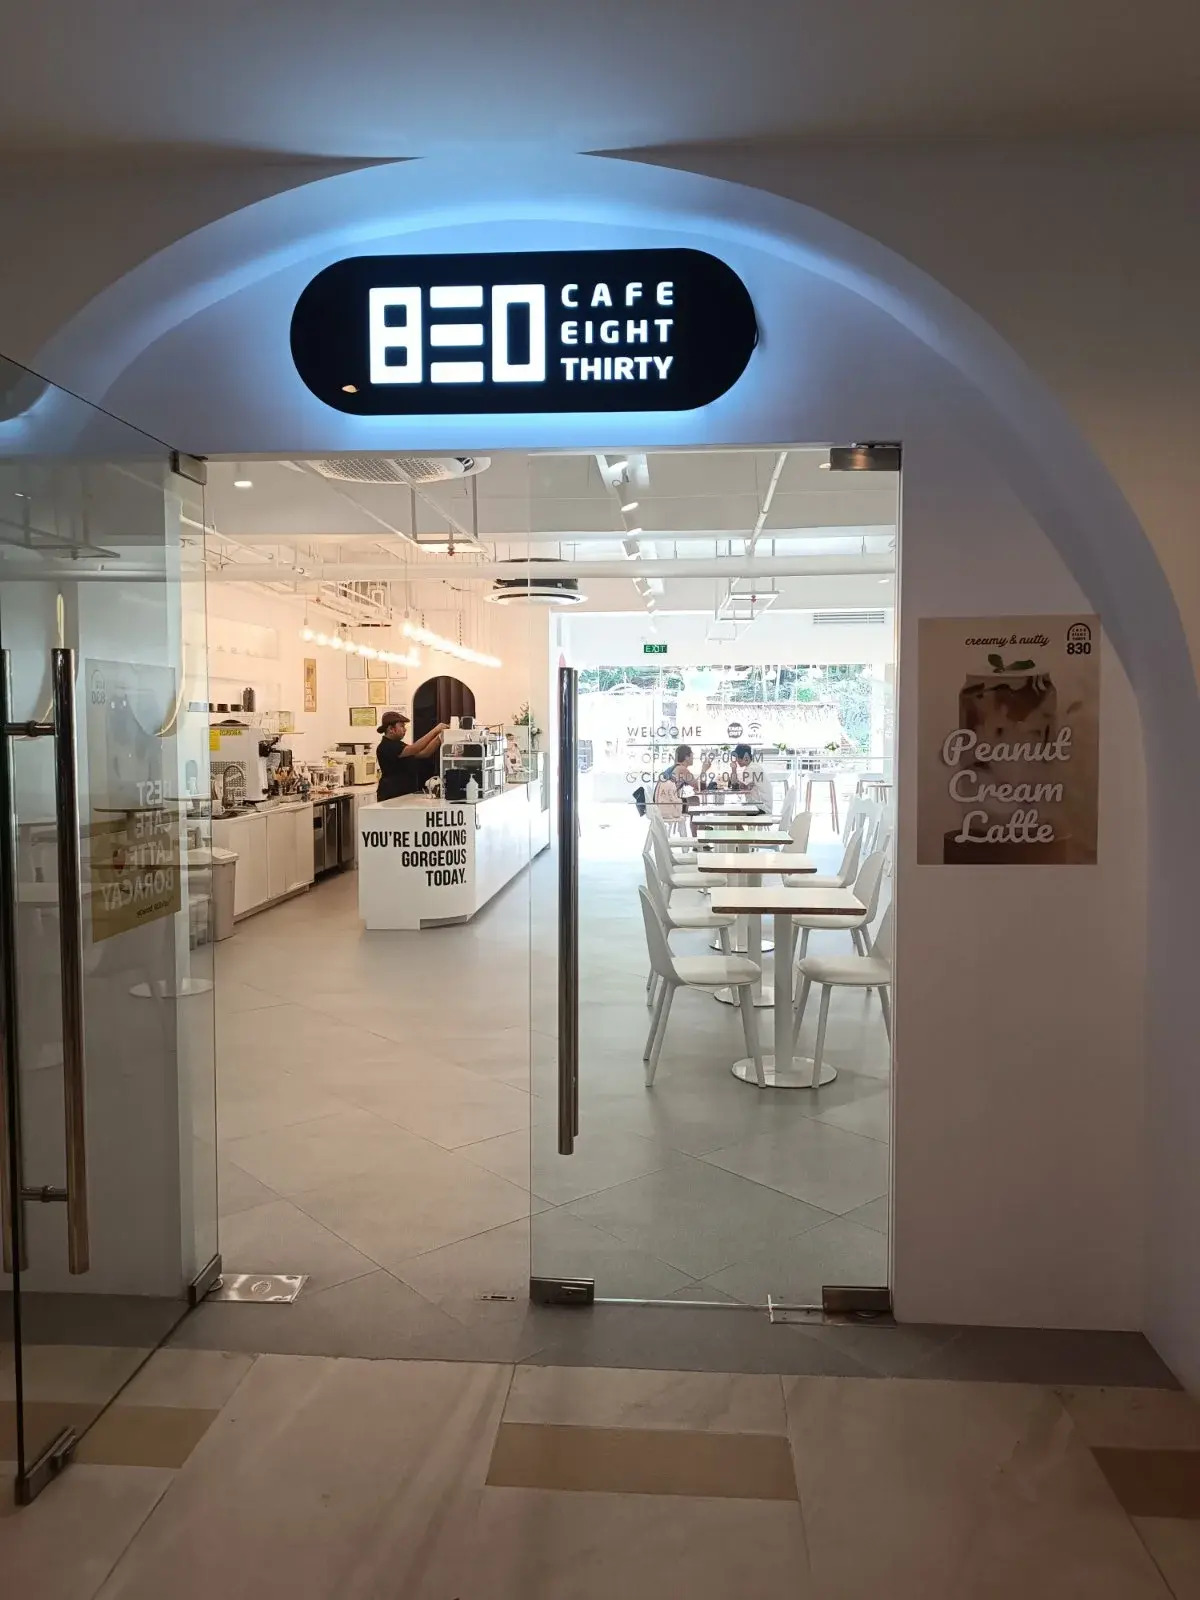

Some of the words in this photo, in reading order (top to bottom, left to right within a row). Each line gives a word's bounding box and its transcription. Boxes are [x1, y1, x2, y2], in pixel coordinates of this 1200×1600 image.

[561, 281, 674, 307] CAFE
[561, 319, 674, 344] EIGHT
[560, 356, 674, 381] THIRTY
[645, 645, 666, 653] EXIT
[965, 636, 1008, 648] creamy
[1009, 635, 1017, 645] &
[1019, 634, 1050, 647] nutty
[1066, 642, 1092, 655] 830
[627, 726, 702, 738] WELCOME
[943, 727, 1072, 766] Peanut
[641, 752, 676, 764] OPEN
[742, 771, 764, 783] PM
[949, 769, 1064, 803] Cream
[426, 810, 467, 828] HELLO.
[954, 809, 1054, 843] Latte
[362, 831, 410, 848] YOU'RE
[414, 829, 467, 848] LOOKING
[401, 848, 467, 868] GORGEOUS
[426, 868, 467, 887] TODAY.
